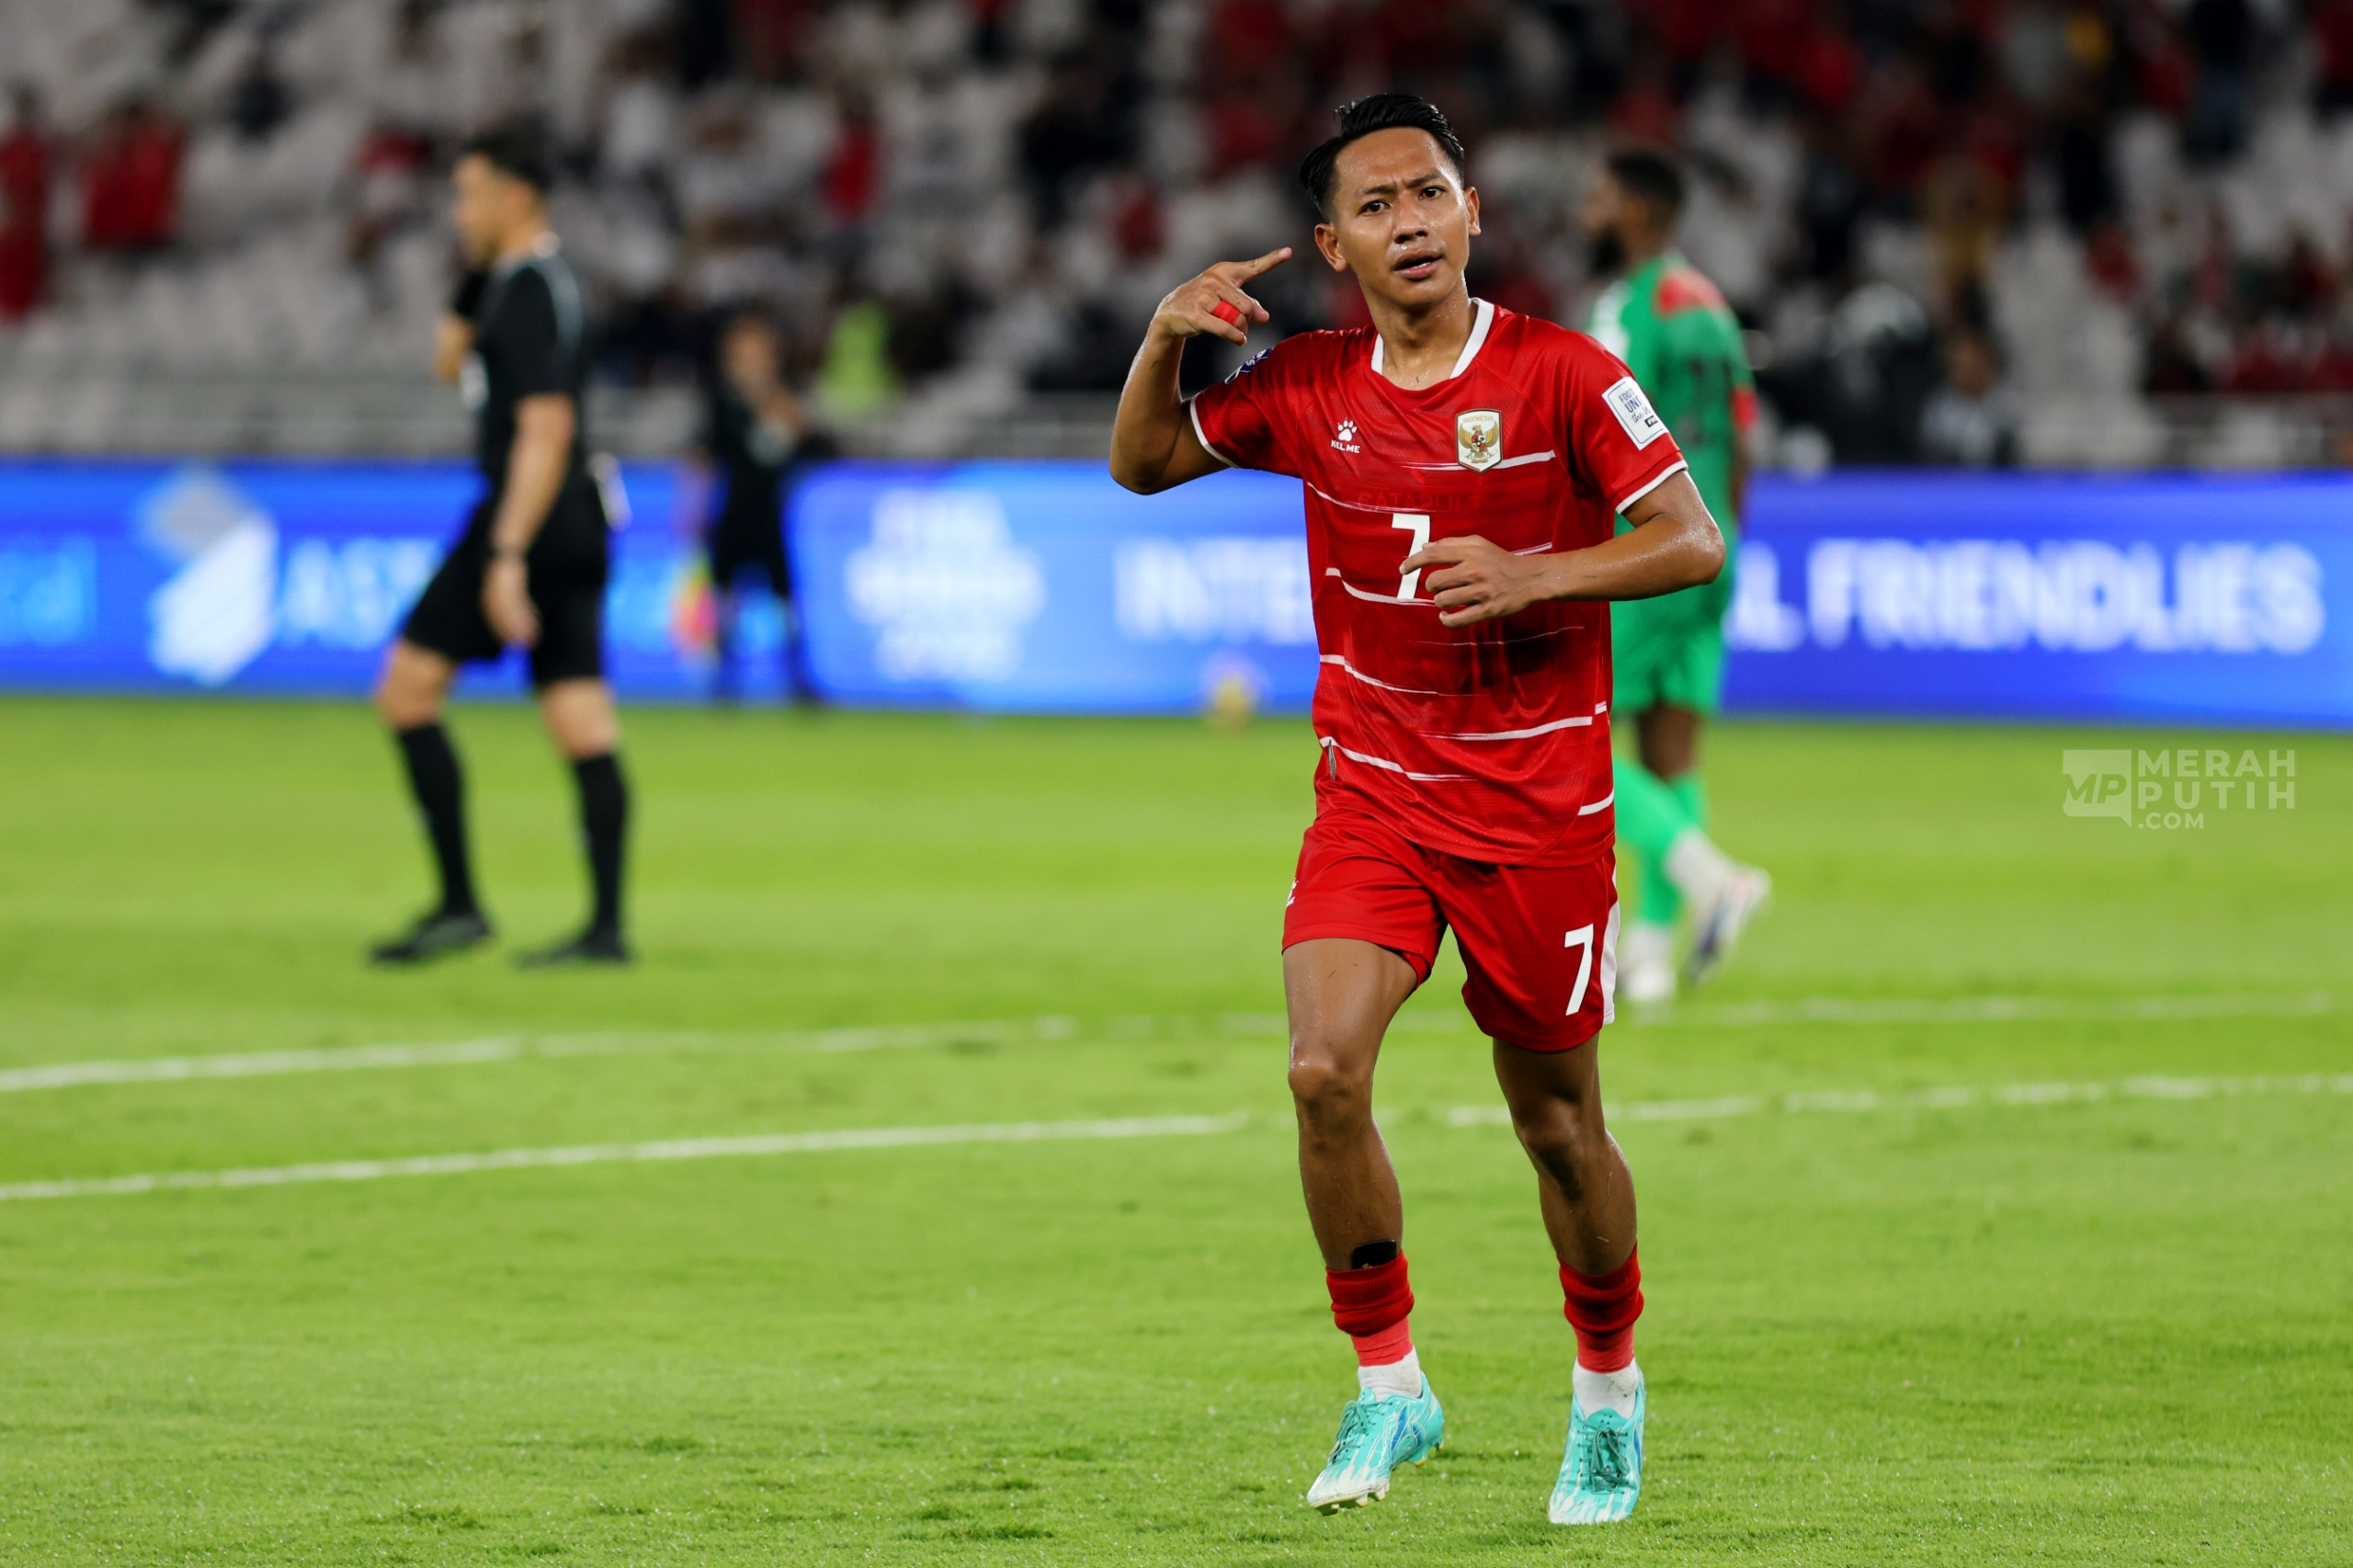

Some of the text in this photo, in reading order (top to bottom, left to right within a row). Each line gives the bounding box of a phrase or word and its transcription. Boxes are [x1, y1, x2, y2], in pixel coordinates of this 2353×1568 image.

[1330, 439, 1360, 454] KELME
[1392, 513, 1430, 600] 7
[1807, 538, 2325, 653] FRIENDLIES
[1564, 923, 1594, 1017] 7
